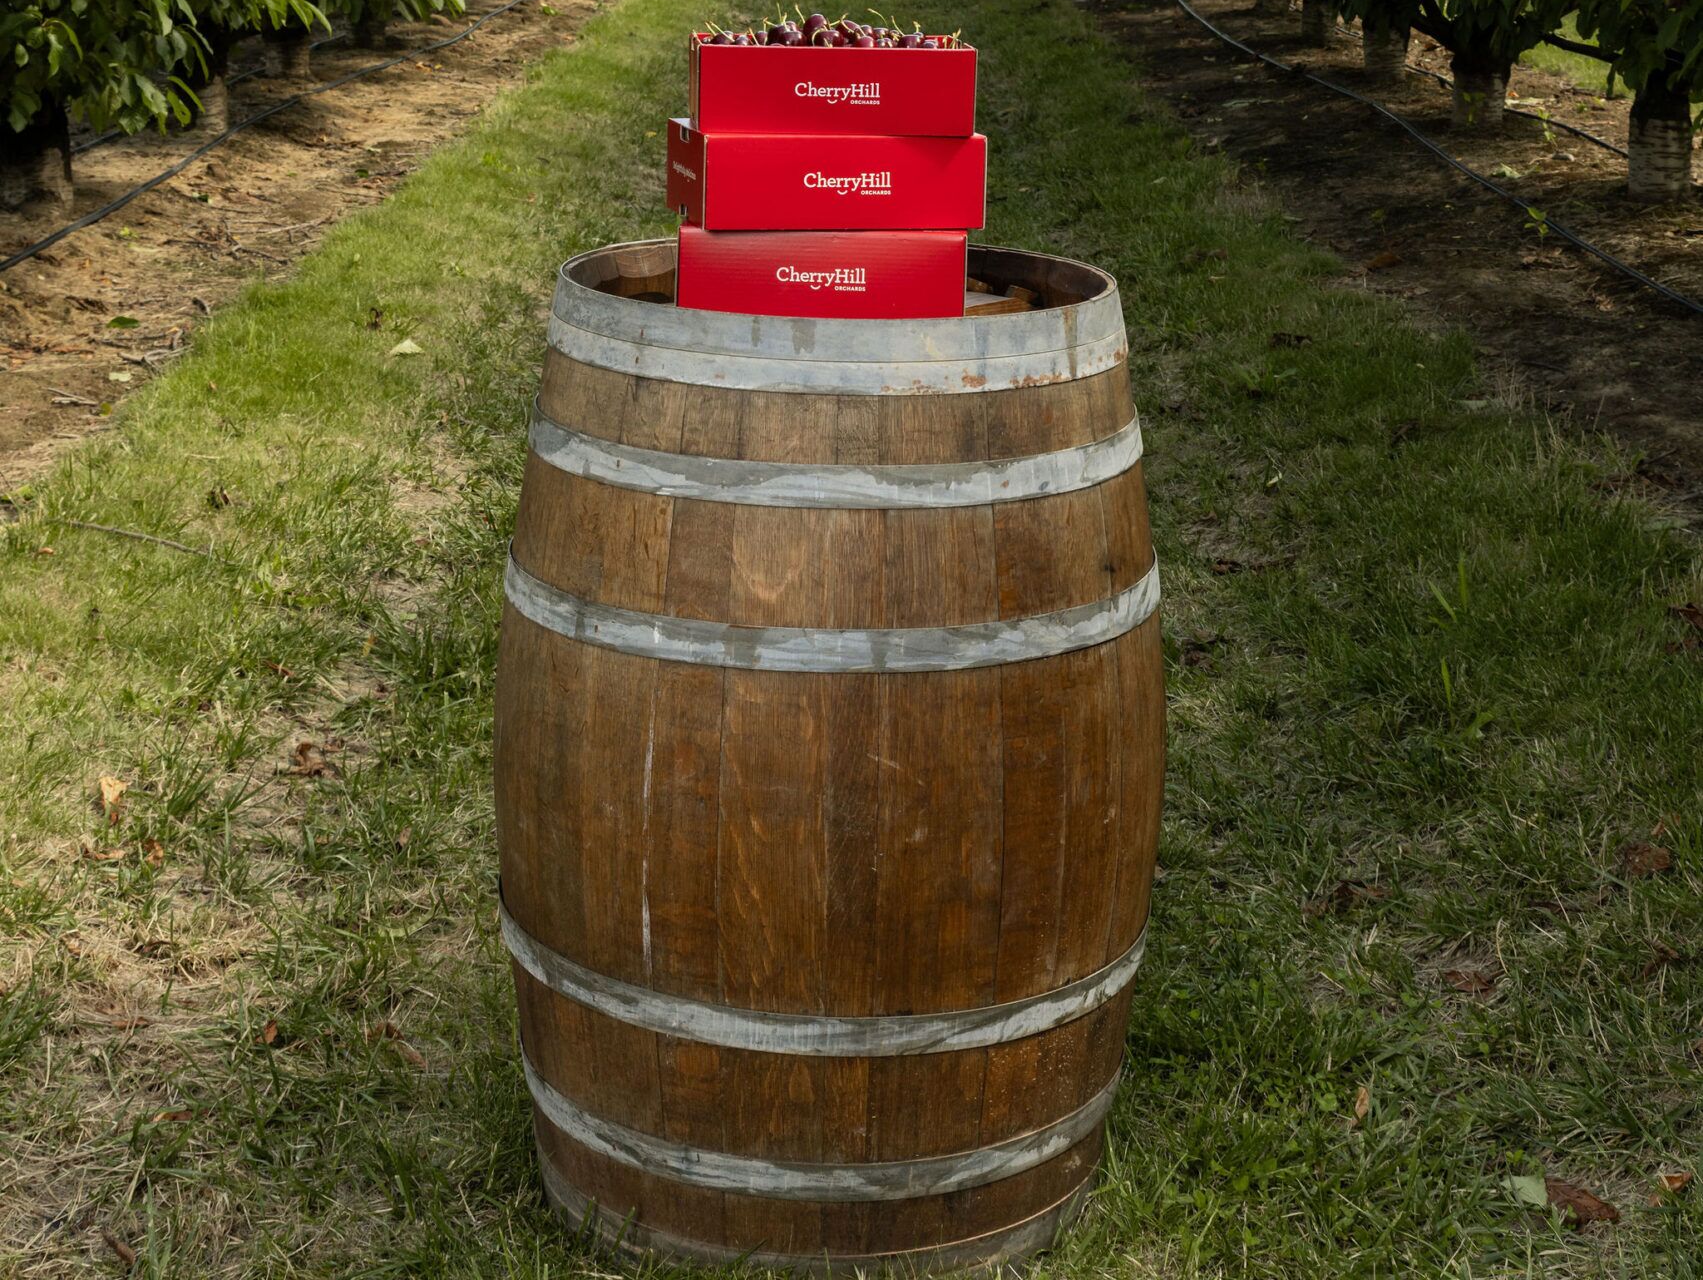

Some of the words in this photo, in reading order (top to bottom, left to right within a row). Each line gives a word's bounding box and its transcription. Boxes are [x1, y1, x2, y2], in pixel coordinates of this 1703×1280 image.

[794, 81, 881, 101] CherryHill
[803, 171, 892, 192] CherryHill
[776, 265, 866, 287] CherryHill
